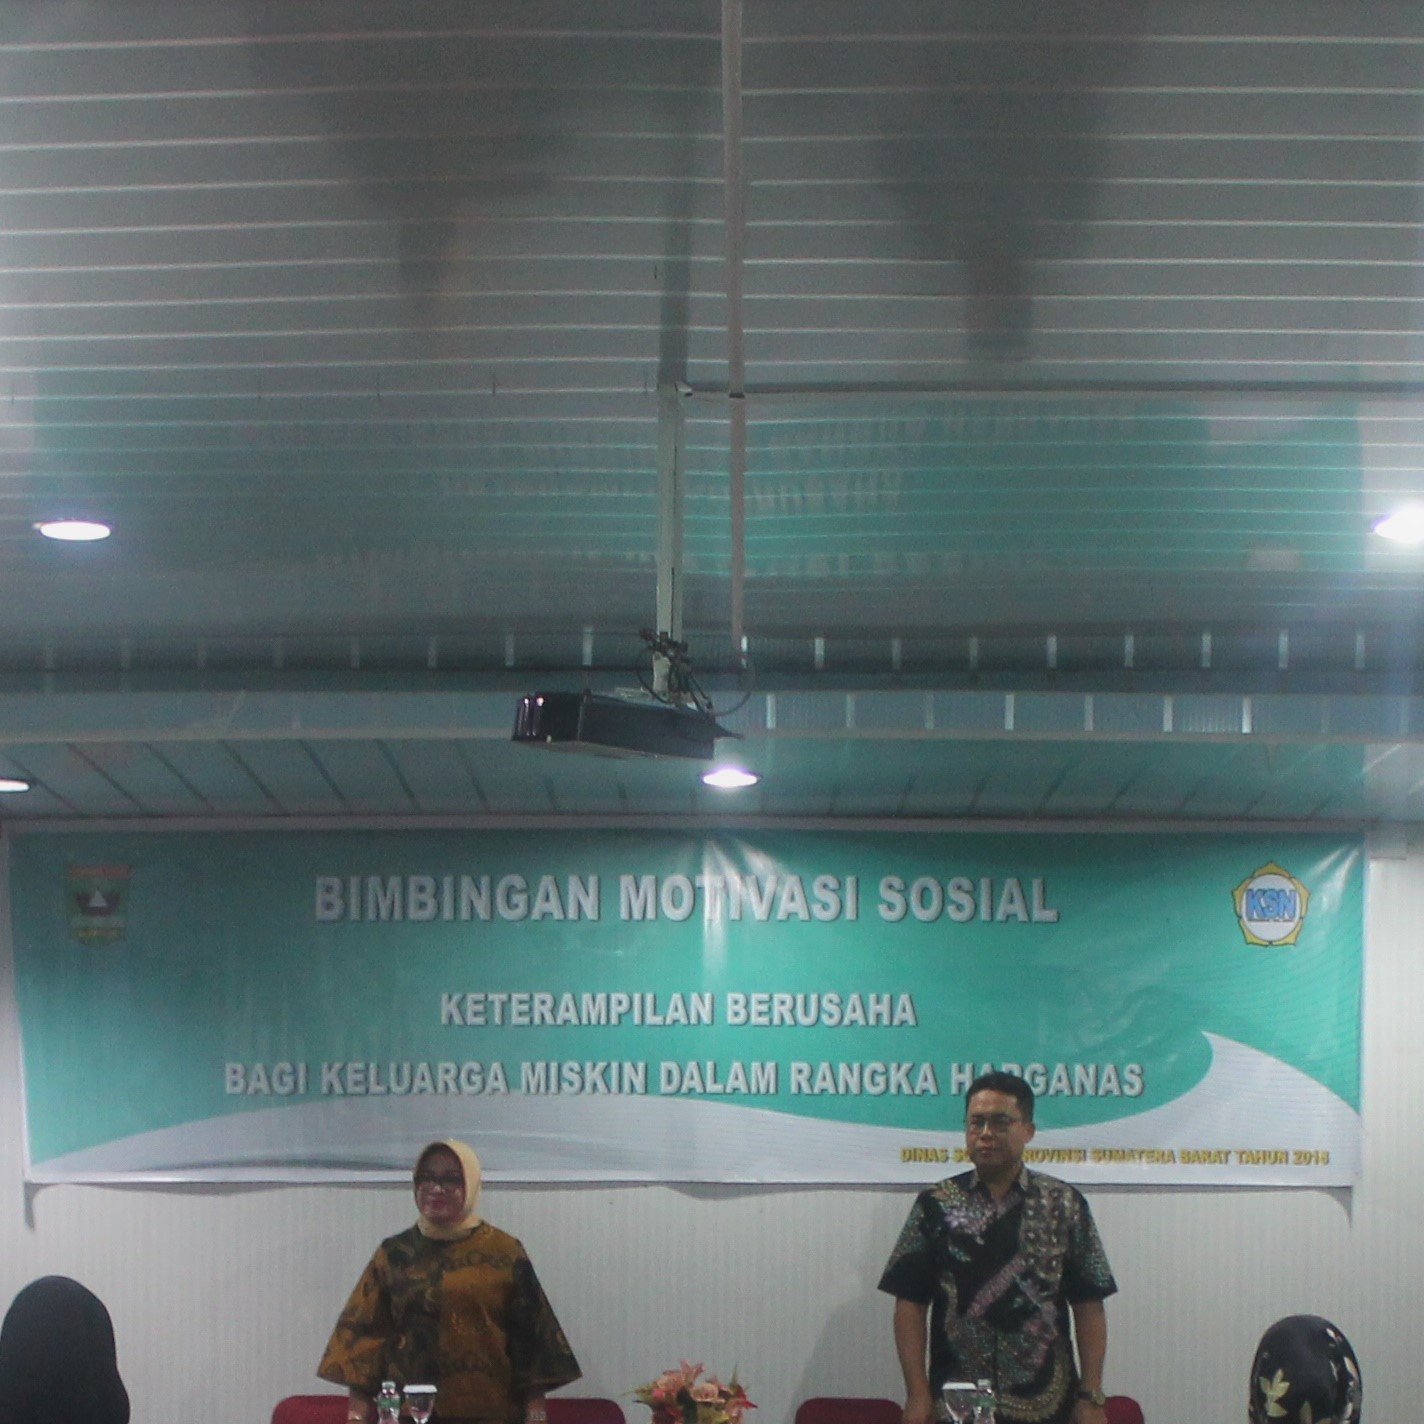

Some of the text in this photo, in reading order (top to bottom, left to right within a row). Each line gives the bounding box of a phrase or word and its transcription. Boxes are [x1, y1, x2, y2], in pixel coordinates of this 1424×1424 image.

[315, 873, 1058, 923] BIMBINGAN MOTIVASI SOSIAL
[1246, 888, 1298, 922] KSN
[440, 992, 917, 1027] KETERAMPILAN BERUSAHA
[224, 1061, 307, 1096] BAGI
[320, 1061, 510, 1096] KELUARGA
[520, 1060, 647, 1096] MISKIN
[659, 1060, 777, 1096] DALAM
[790, 1061, 939, 1096] RANGKA
[901, 1147, 949, 1163] DINAS
[1022, 1148, 1087, 1164] ROVINSI
[1090, 1148, 1176, 1165] SUMATERA
[1180, 1149, 1230, 1166] BARAT
[1236, 1149, 1289, 1166] TAHUN
